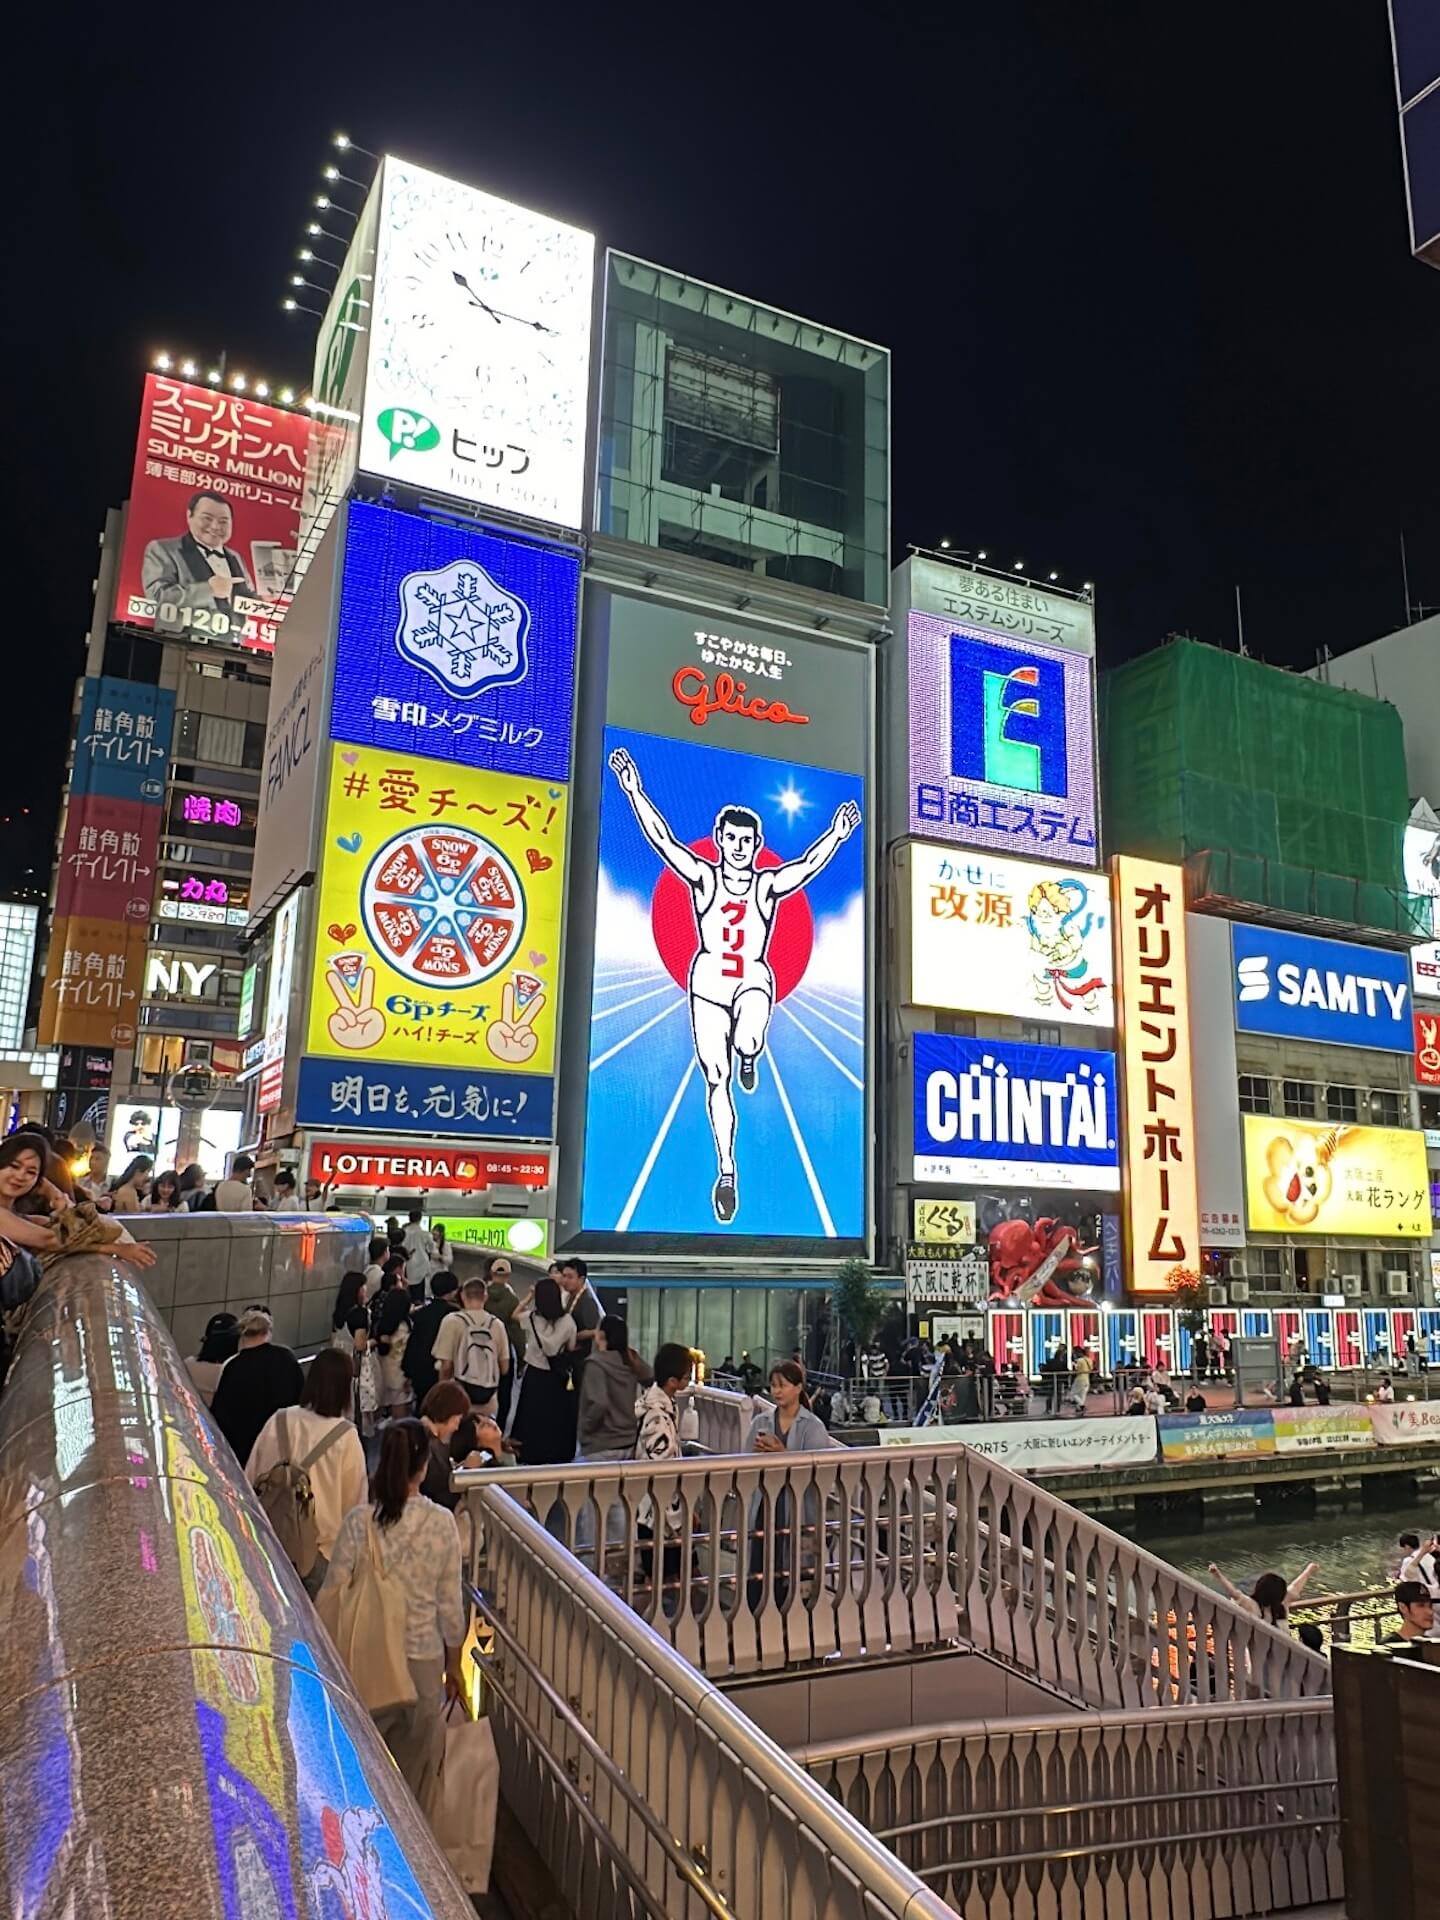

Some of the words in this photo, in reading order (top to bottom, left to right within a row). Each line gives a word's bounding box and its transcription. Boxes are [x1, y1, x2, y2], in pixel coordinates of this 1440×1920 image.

[153, 382, 273, 430] スーパー
[147, 438, 221, 469] SUPER
[226, 458, 302, 490] MILLION
[959, 575, 1049, 613] 夢ある住まい
[943, 597, 1065, 643] エステムシリーズ
[693, 631, 793, 667] すこやかな毎日、
[701, 650, 783, 680] ゆたかな人生
[672, 666, 809, 725] Glico
[94, 707, 156, 739] 龍角散
[371, 695, 544, 748] 雪印メグミルク
[184, 795, 241, 826] 焼肉
[916, 783, 1096, 848] 日商エステム
[79, 825, 142, 857] 龍角散
[431, 838, 471, 854] SNOW
[383, 850, 408, 884] SNOW
[181, 877, 228, 903] 力丸
[930, 884, 1014, 928] 改源
[376, 911, 402, 947] SNOW
[482, 926, 508, 960] SNOW
[720, 900, 748, 979] グリコ
[62, 949, 127, 979] 龍角散
[421, 959, 460, 973] SNOW
[1278, 962, 1408, 1021] SAMTY
[1134, 883, 1187, 1262] オリエントホーム
[926, 1054, 1116, 1150] CHINTAI
[322, 1154, 450, 1177] LOTTERIA
[1366, 1186, 1425, 1210] 花ラング
[927, 1205, 964, 1237] くくる
[911, 1267, 977, 1296] 大阪に乾杯
